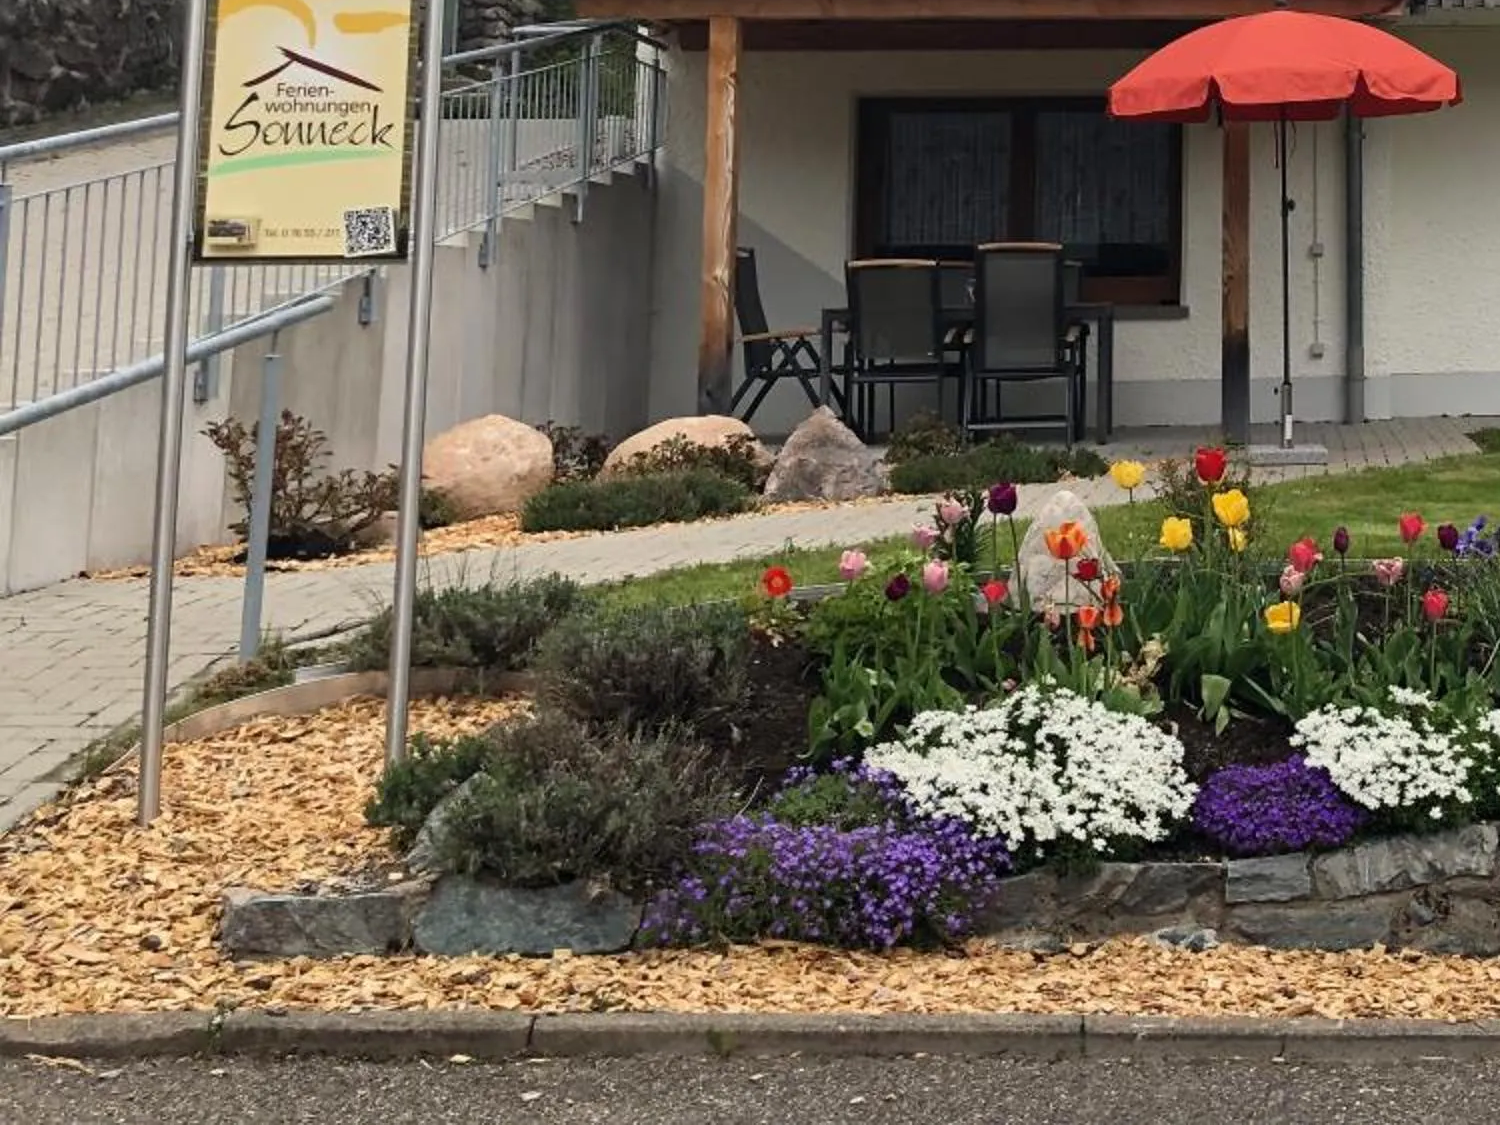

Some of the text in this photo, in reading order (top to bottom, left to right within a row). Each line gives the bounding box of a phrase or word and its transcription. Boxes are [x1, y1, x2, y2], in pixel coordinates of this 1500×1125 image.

[277, 83, 335, 98] Ferien-
[265, 99, 371, 117] wohnungen
[217, 91, 397, 156] Sonneck
